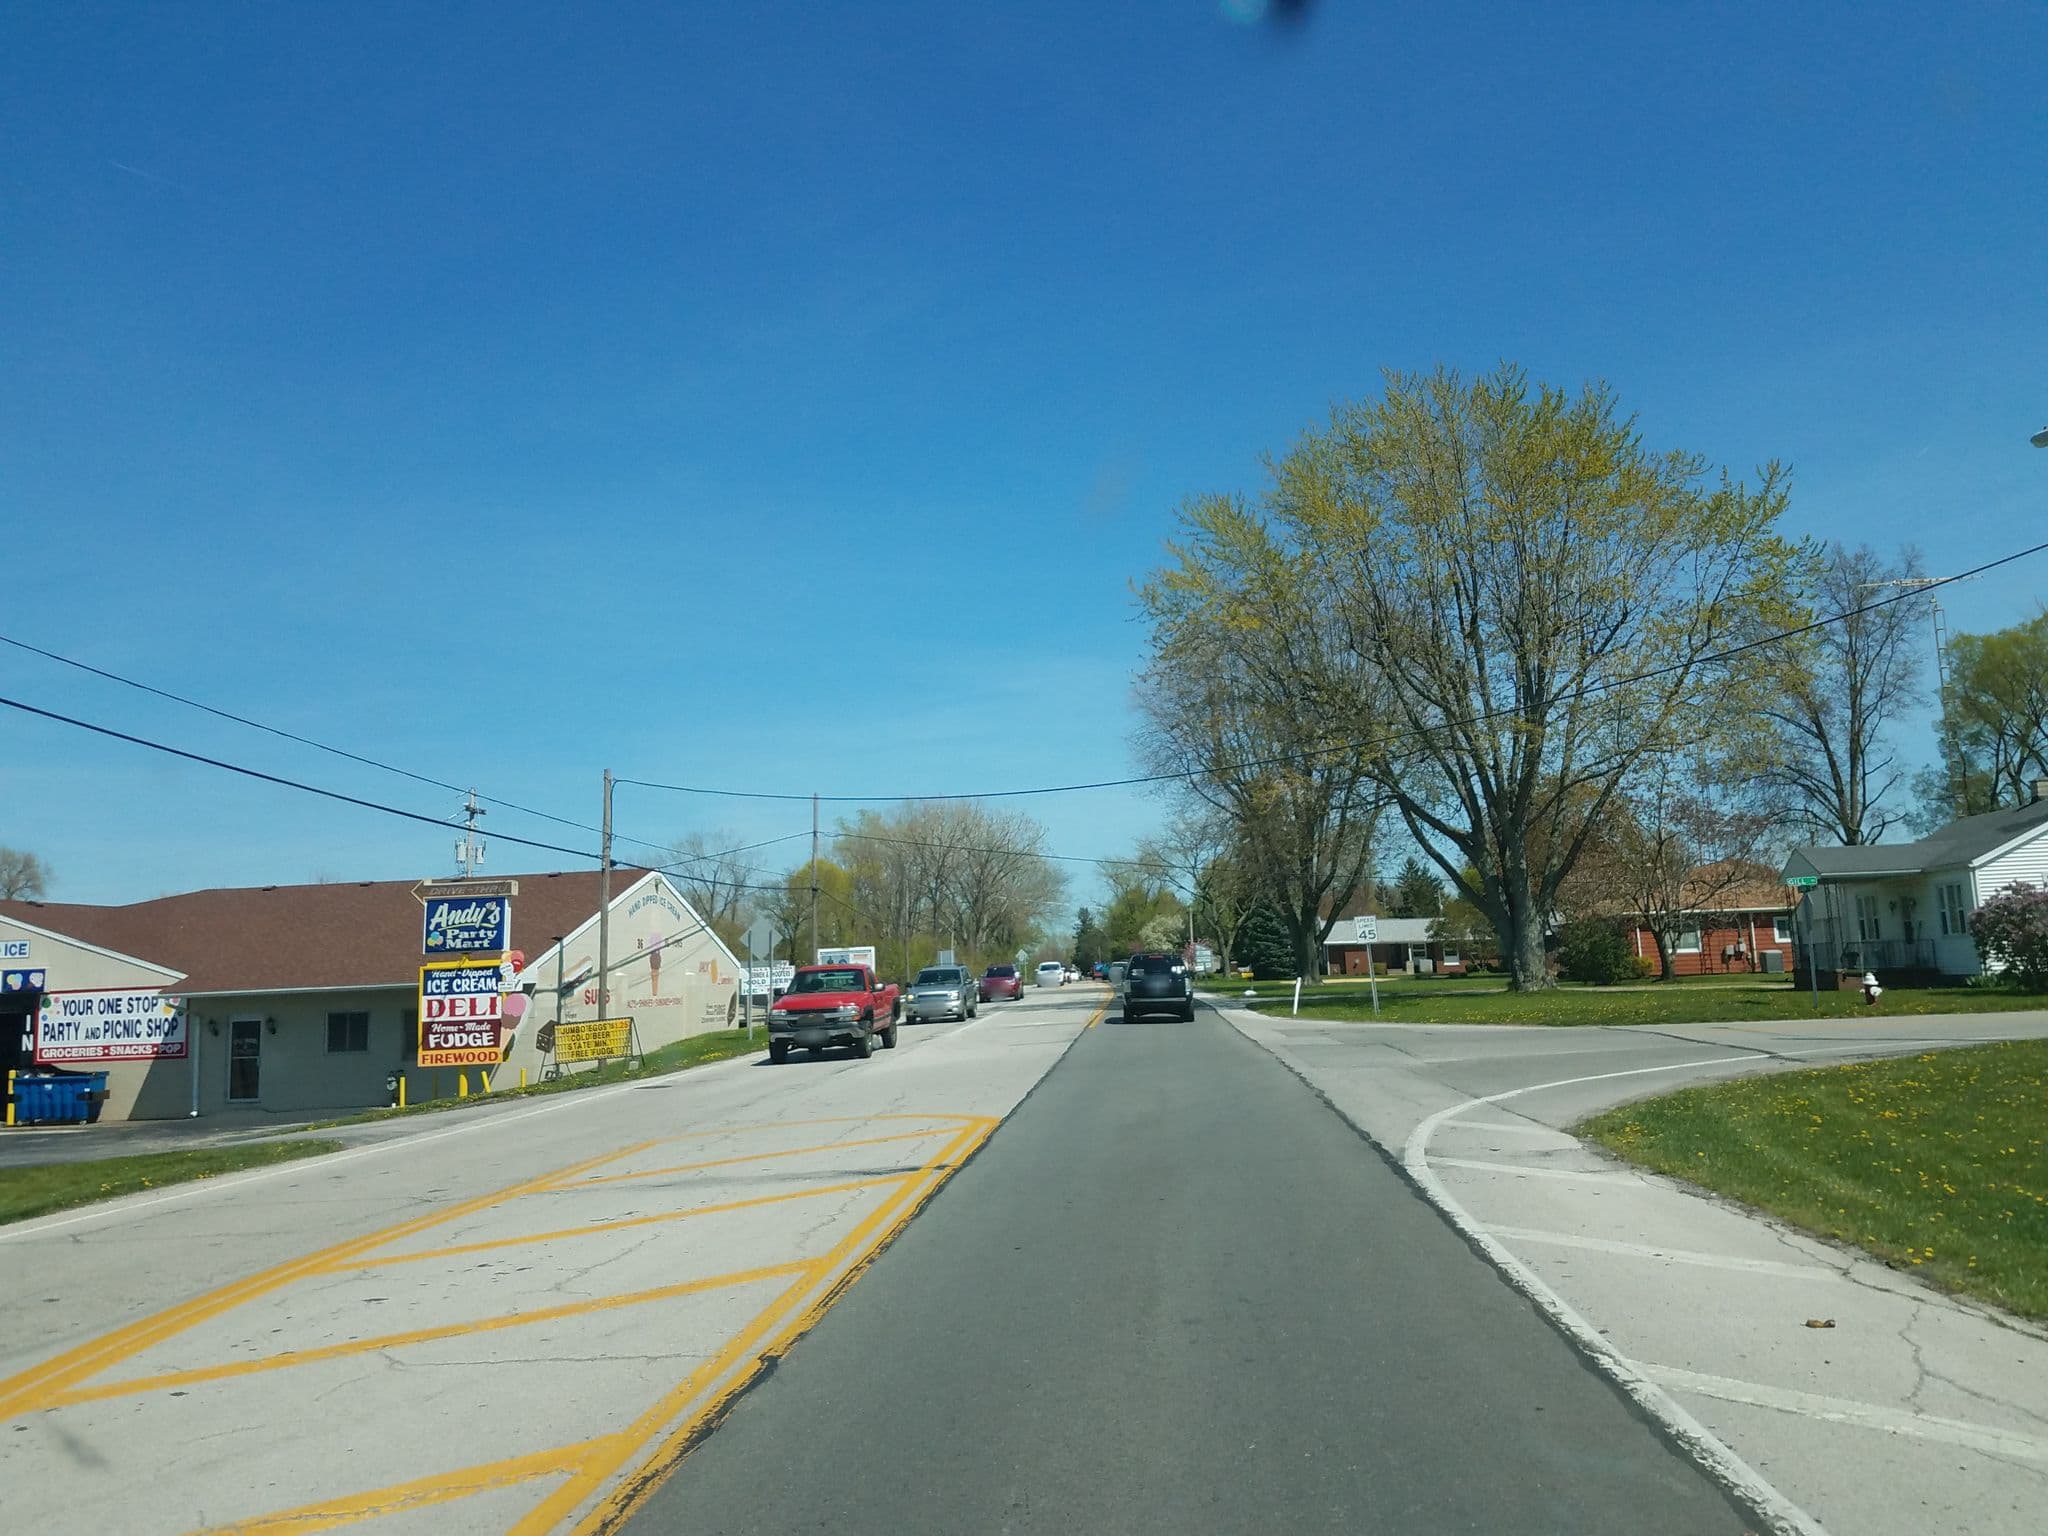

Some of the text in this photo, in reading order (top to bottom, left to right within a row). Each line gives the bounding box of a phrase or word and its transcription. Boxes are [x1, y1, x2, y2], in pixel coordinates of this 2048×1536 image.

[430, 901, 501, 931] Andy's
[446, 929, 497, 940] Party
[1359, 929, 1376, 940] 45
[5, 943, 27, 956] ICE
[445, 939, 491, 949] Mart
[427, 979, 450, 994] ICE
[454, 977, 498, 993] CREAM
[584, 989, 610, 1005] SUS
[62, 996, 159, 1016] YOUR ONE STOP
[426, 996, 498, 1019] DELI
[43, 1017, 179, 1042] PARTY AND PICNIC SHOP
[431, 1022, 491, 1033] Home-Made
[561, 1025, 586, 1035] JUMBO
[588, 1023, 608, 1032] EGGS
[428, 1032, 495, 1048] FUDGE
[571, 1031, 610, 1041] COLD BEER
[42, 1044, 181, 1058] GROCERIES SNACKS POP
[568, 1041, 591, 1050] STATE
[421, 1051, 499, 1065] FIREWOOD
[571, 1047, 615, 1058] FREE FUDGE
